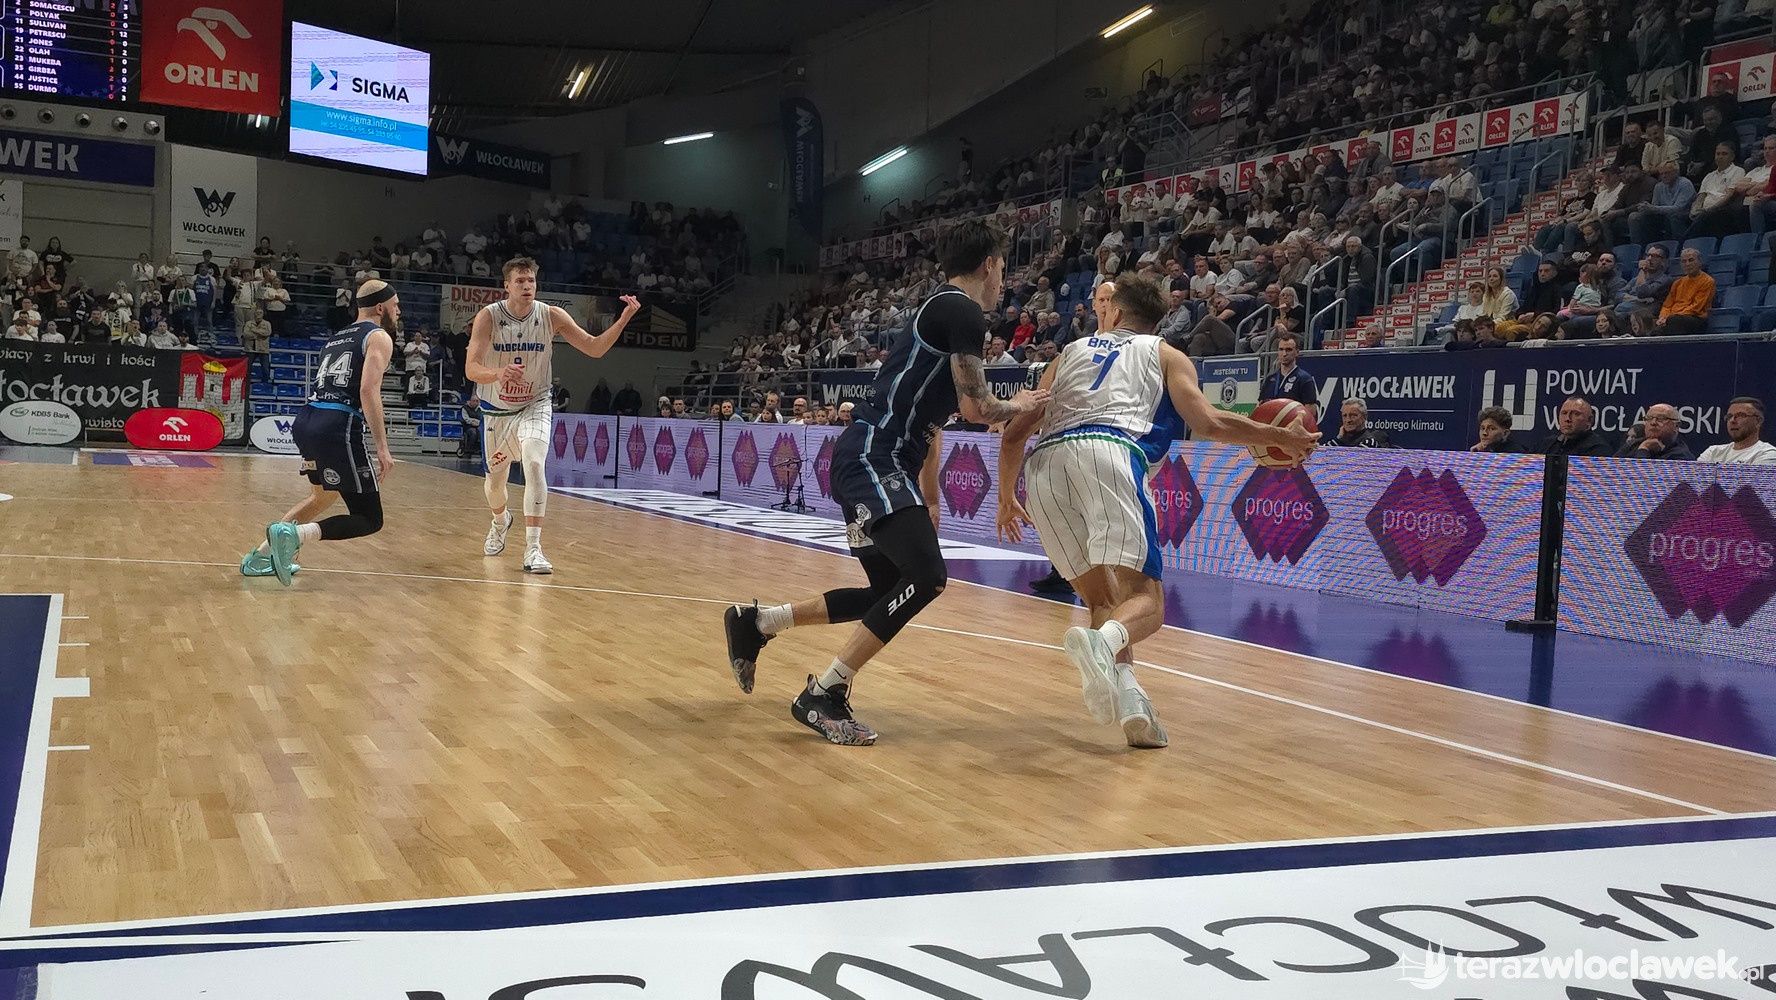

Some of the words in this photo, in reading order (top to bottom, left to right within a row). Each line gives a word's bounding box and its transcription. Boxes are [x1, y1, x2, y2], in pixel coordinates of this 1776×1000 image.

[29, 1, 75, 12] SOMACESCU
[29, 10, 60, 20] POLYAK
[29, 19, 67, 30] SULLIVAN
[29, 28, 66, 39] PETRESCU
[28, 38, 54, 46] JONES
[28, 47, 51, 56] OLAH
[28, 56, 62, 66] MUKEBA
[28, 74, 58, 85] JUSTICE
[164, 62, 259, 93] ORLEN
[28, 84, 57, 93] DURMO
[352, 77, 409, 103] SIGMA
[1743, 83, 1766, 93] ORLEN
[1436, 142, 1453, 150] ORLEN
[1458, 137, 1475, 146] ORLEN
[182, 221, 246, 238] WŁOCŁAWEK
[623, 331, 688, 348] FIDEM
[44, 353, 52, 363] z
[63, 351, 96, 365] krwi
[106, 352, 111, 366] i
[121, 352, 156, 368] kości
[1090, 350, 1120, 390] 7
[1239, 367, 1249, 375] TU
[1342, 375, 1456, 399] WŁOCŁAWEK
[1545, 368, 1643, 395] POWIAT
[53, 411, 70, 420] Bank
[1374, 419, 1409, 431] dobrego
[1410, 418, 1444, 431] klimatu
[159, 433, 191, 442] ORLEN
[945, 469, 984, 490] progres
[1244, 495, 1314, 526] progres
[1381, 506, 1468, 542] progres
[1649, 530, 1775, 572] progres
